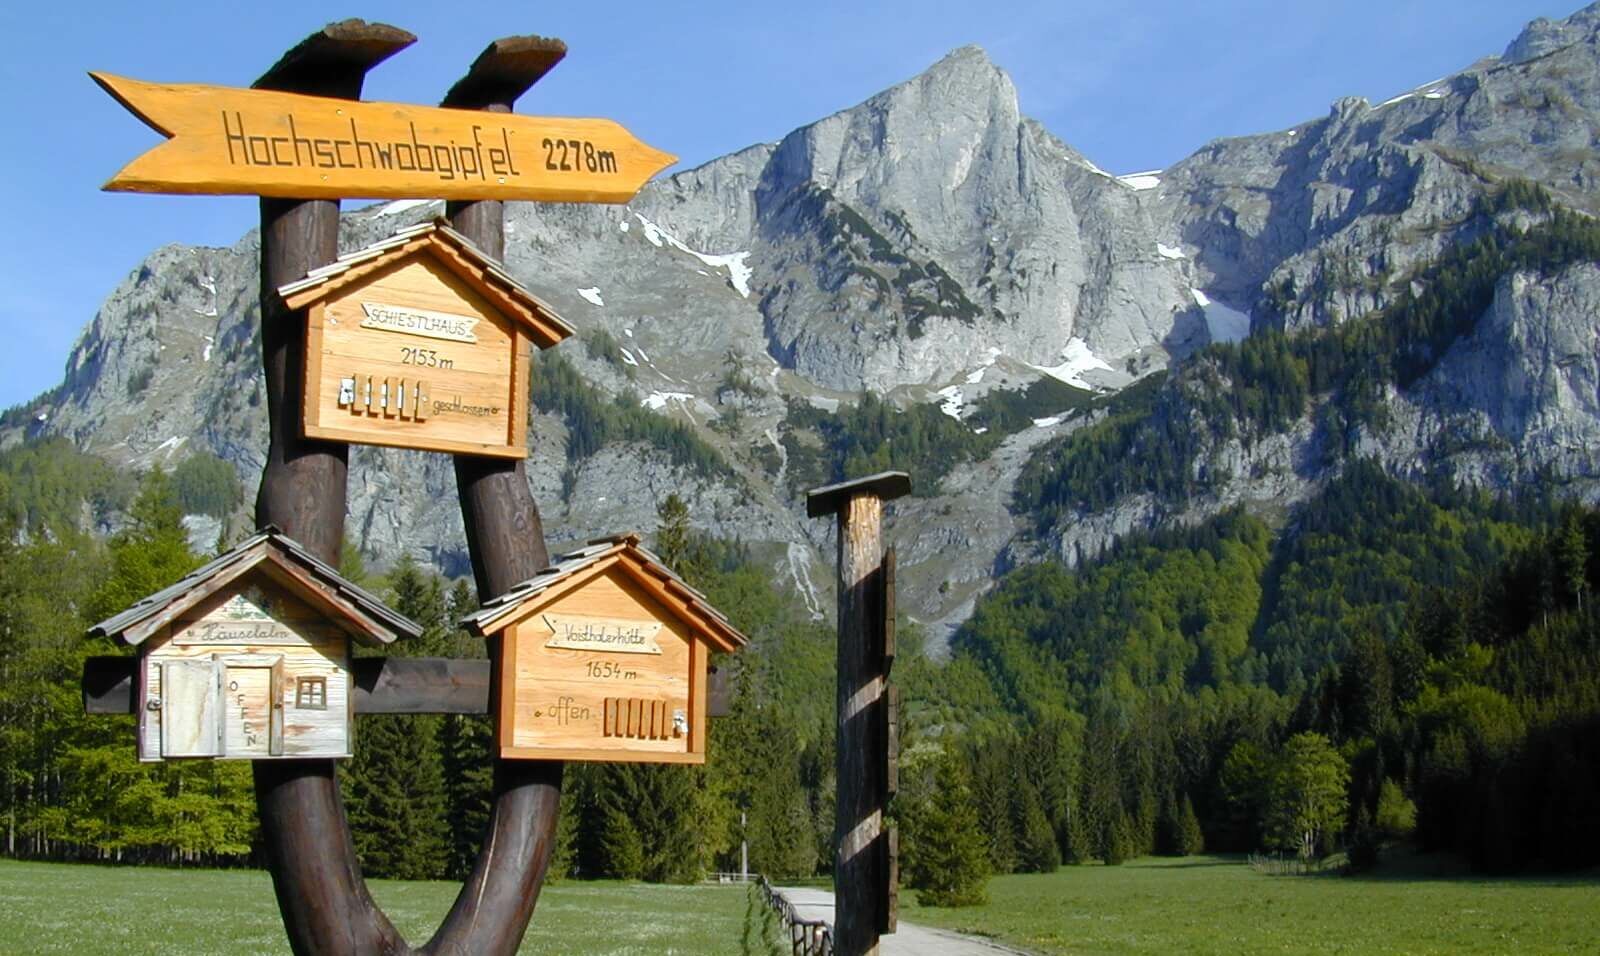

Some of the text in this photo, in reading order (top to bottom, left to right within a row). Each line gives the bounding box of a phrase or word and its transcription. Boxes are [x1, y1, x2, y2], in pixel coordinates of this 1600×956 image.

[222, 111, 617, 181] Hochschwabgipfel 2278m
[371, 308, 466, 336] SCHIESTLHAUS
[401, 347, 454, 370] 2153 m
[585, 662, 637, 680] 1654 m
[548, 696, 590, 726] offen
